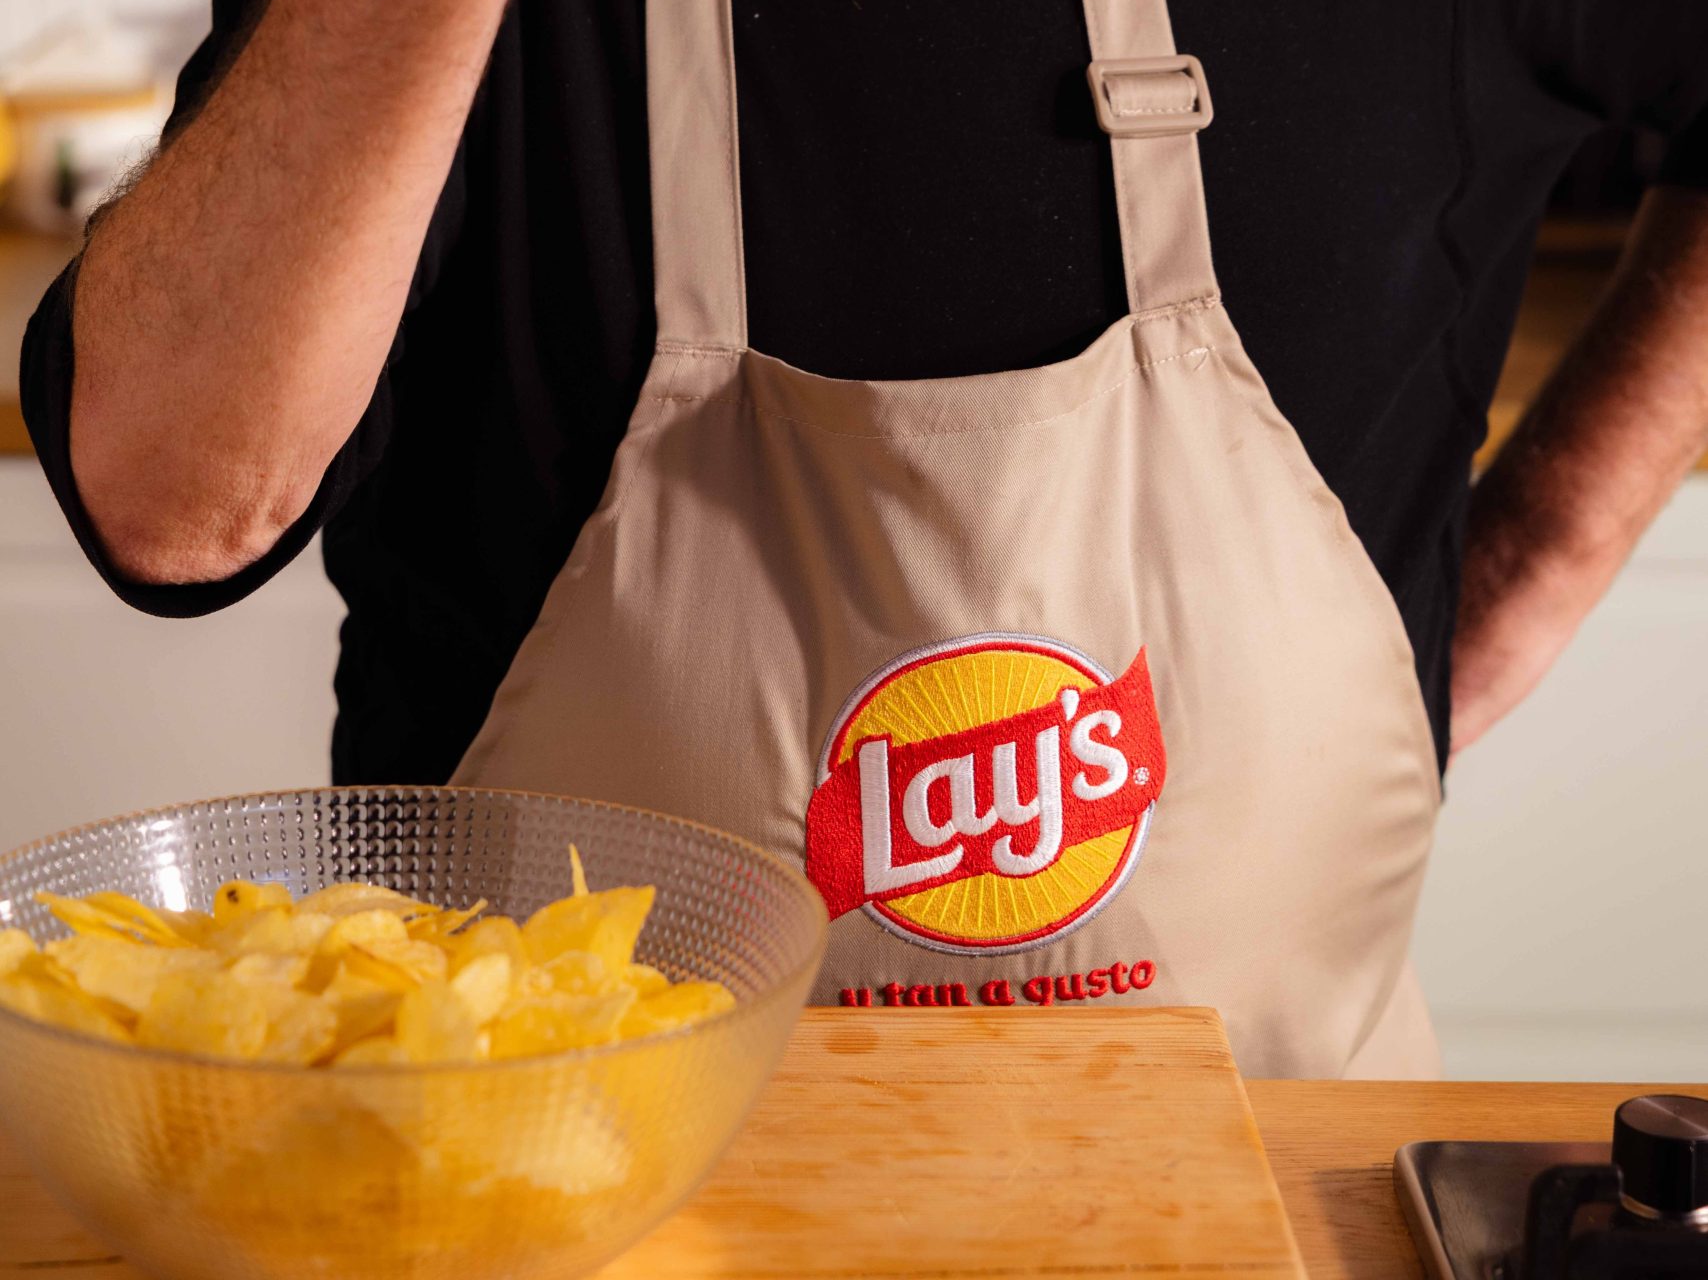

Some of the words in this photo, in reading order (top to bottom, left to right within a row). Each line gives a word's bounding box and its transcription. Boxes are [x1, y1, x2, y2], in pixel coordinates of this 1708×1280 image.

[858, 687, 1130, 895] Lay's
[881, 981, 973, 1008] tan
[979, 979, 1016, 1007] a
[1022, 959, 1157, 1007] gusto
